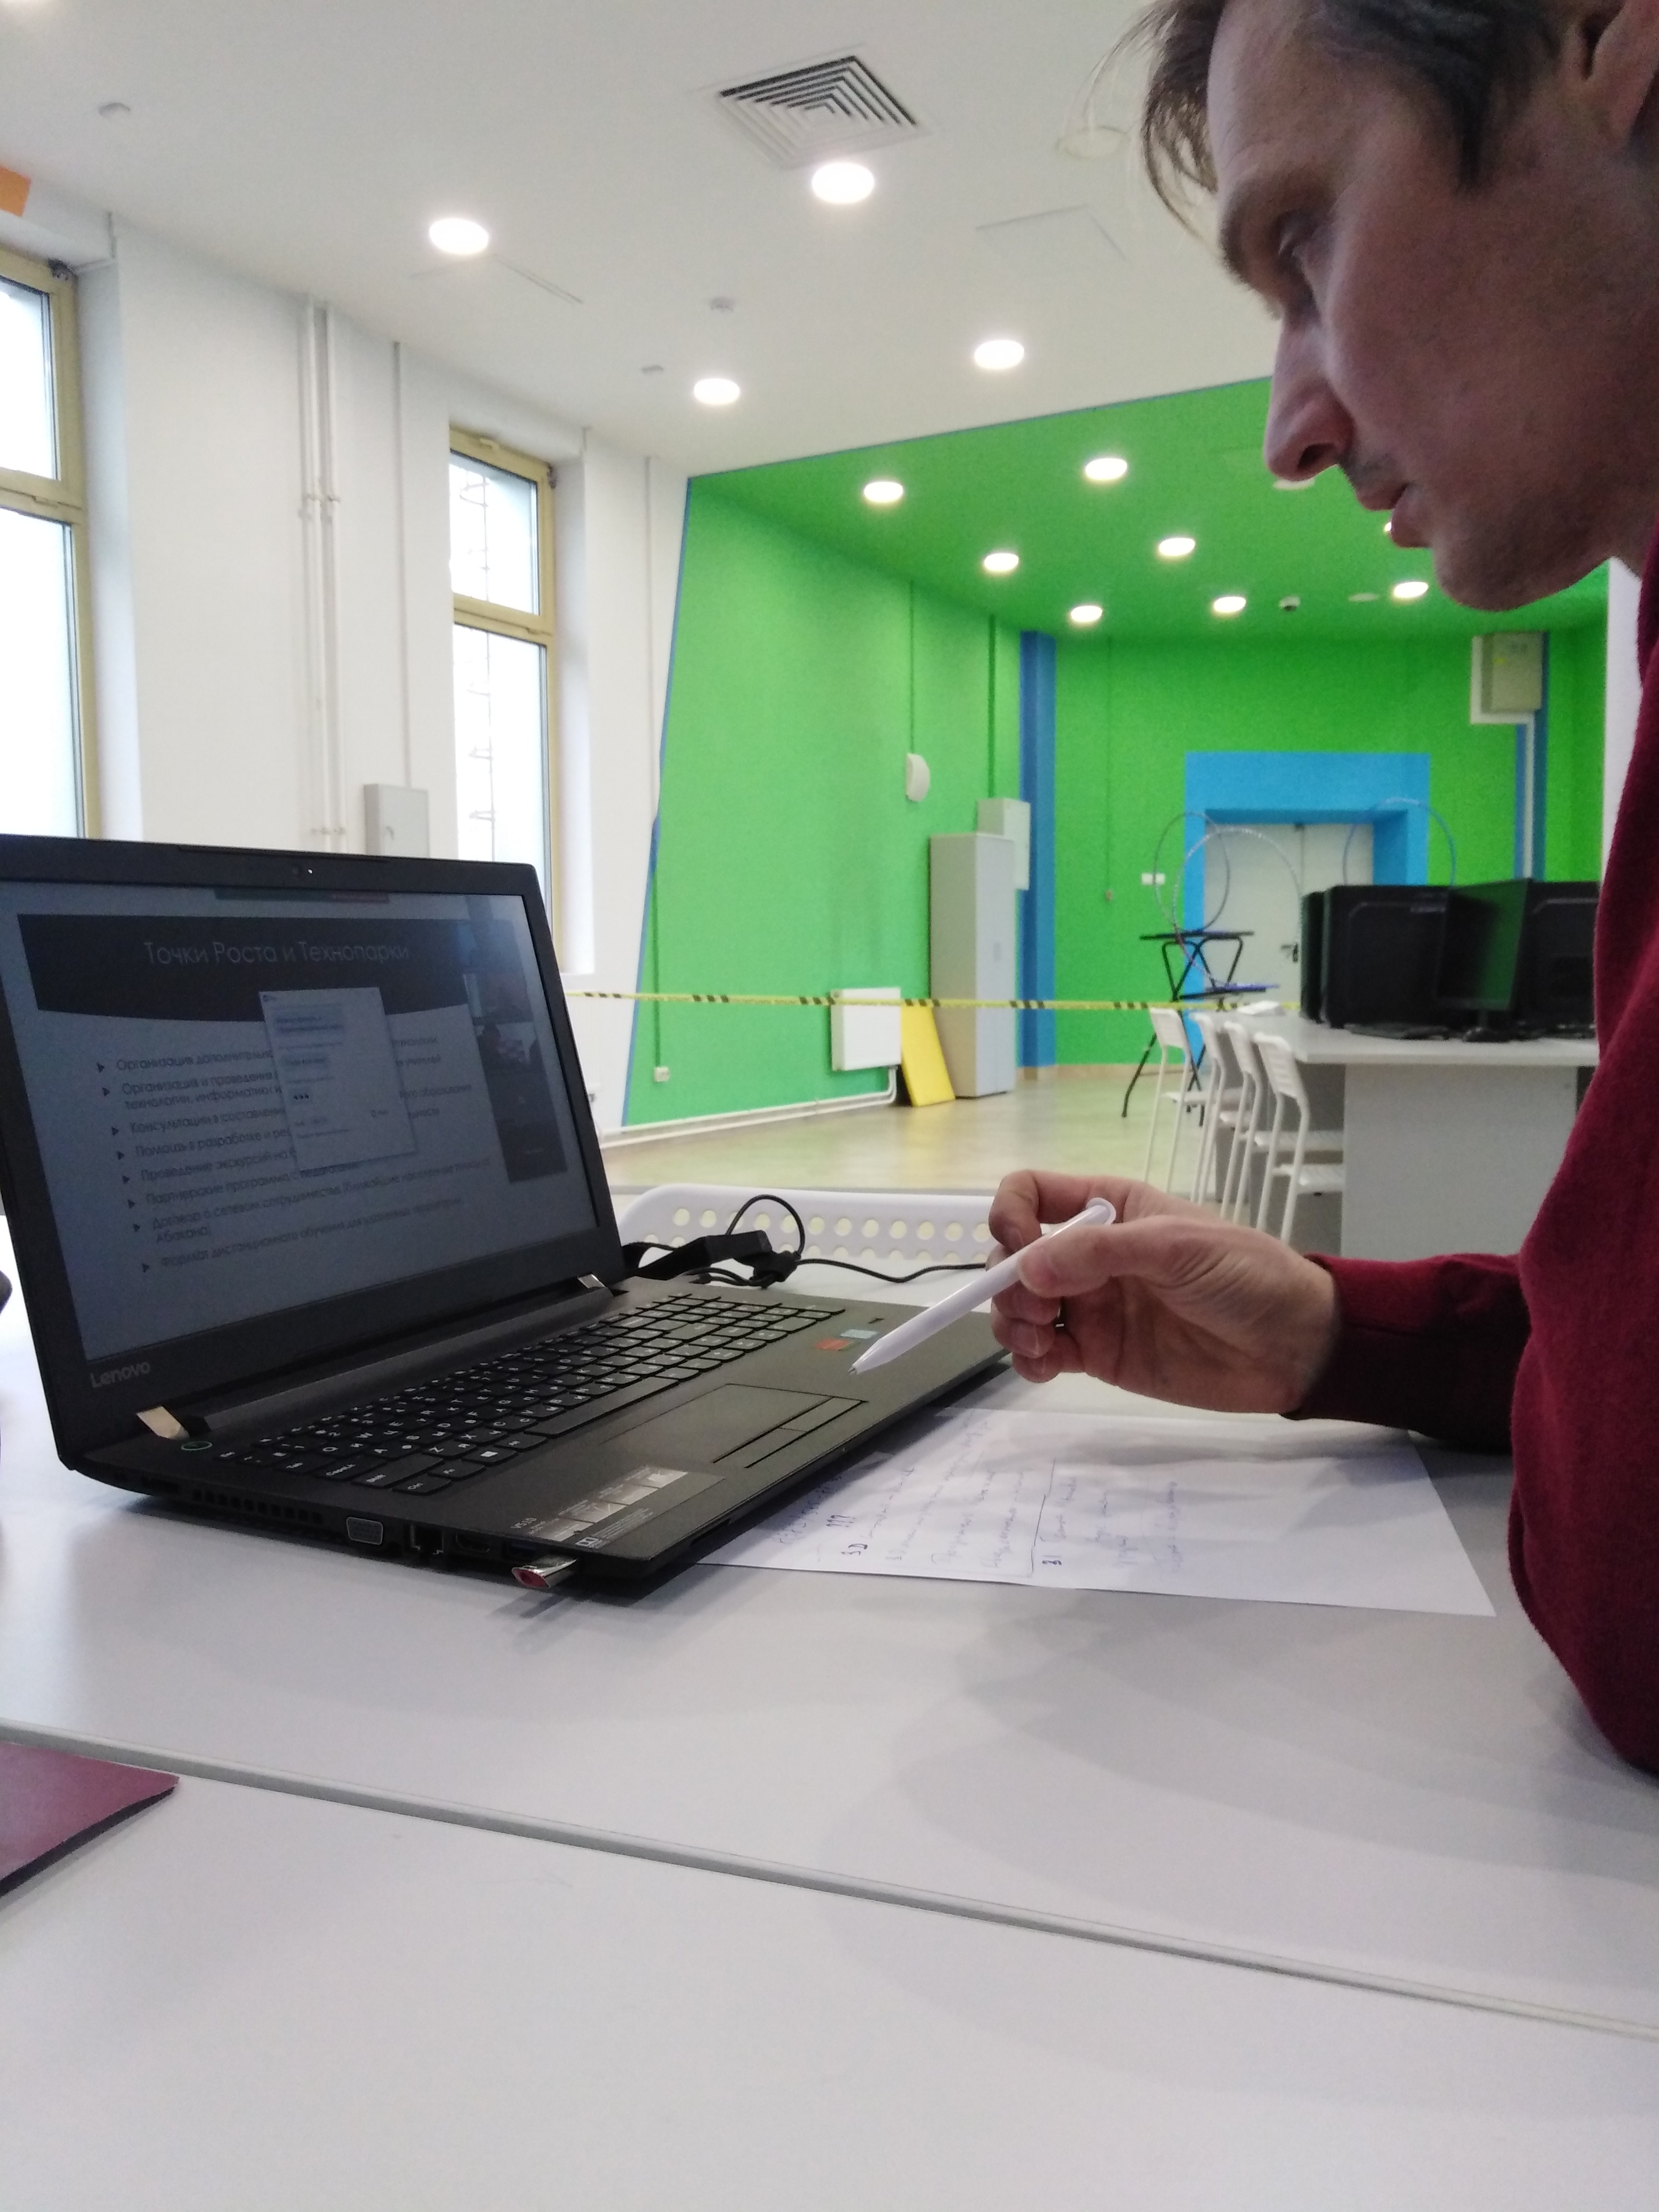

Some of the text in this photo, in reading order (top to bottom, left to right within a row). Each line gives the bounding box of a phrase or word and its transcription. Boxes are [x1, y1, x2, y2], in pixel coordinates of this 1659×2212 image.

[144, 941, 409, 965] Точки Роста и Технопарки
[89, 1361, 151, 1388] Lenovo
[510, 1517, 537, 1529] V510
